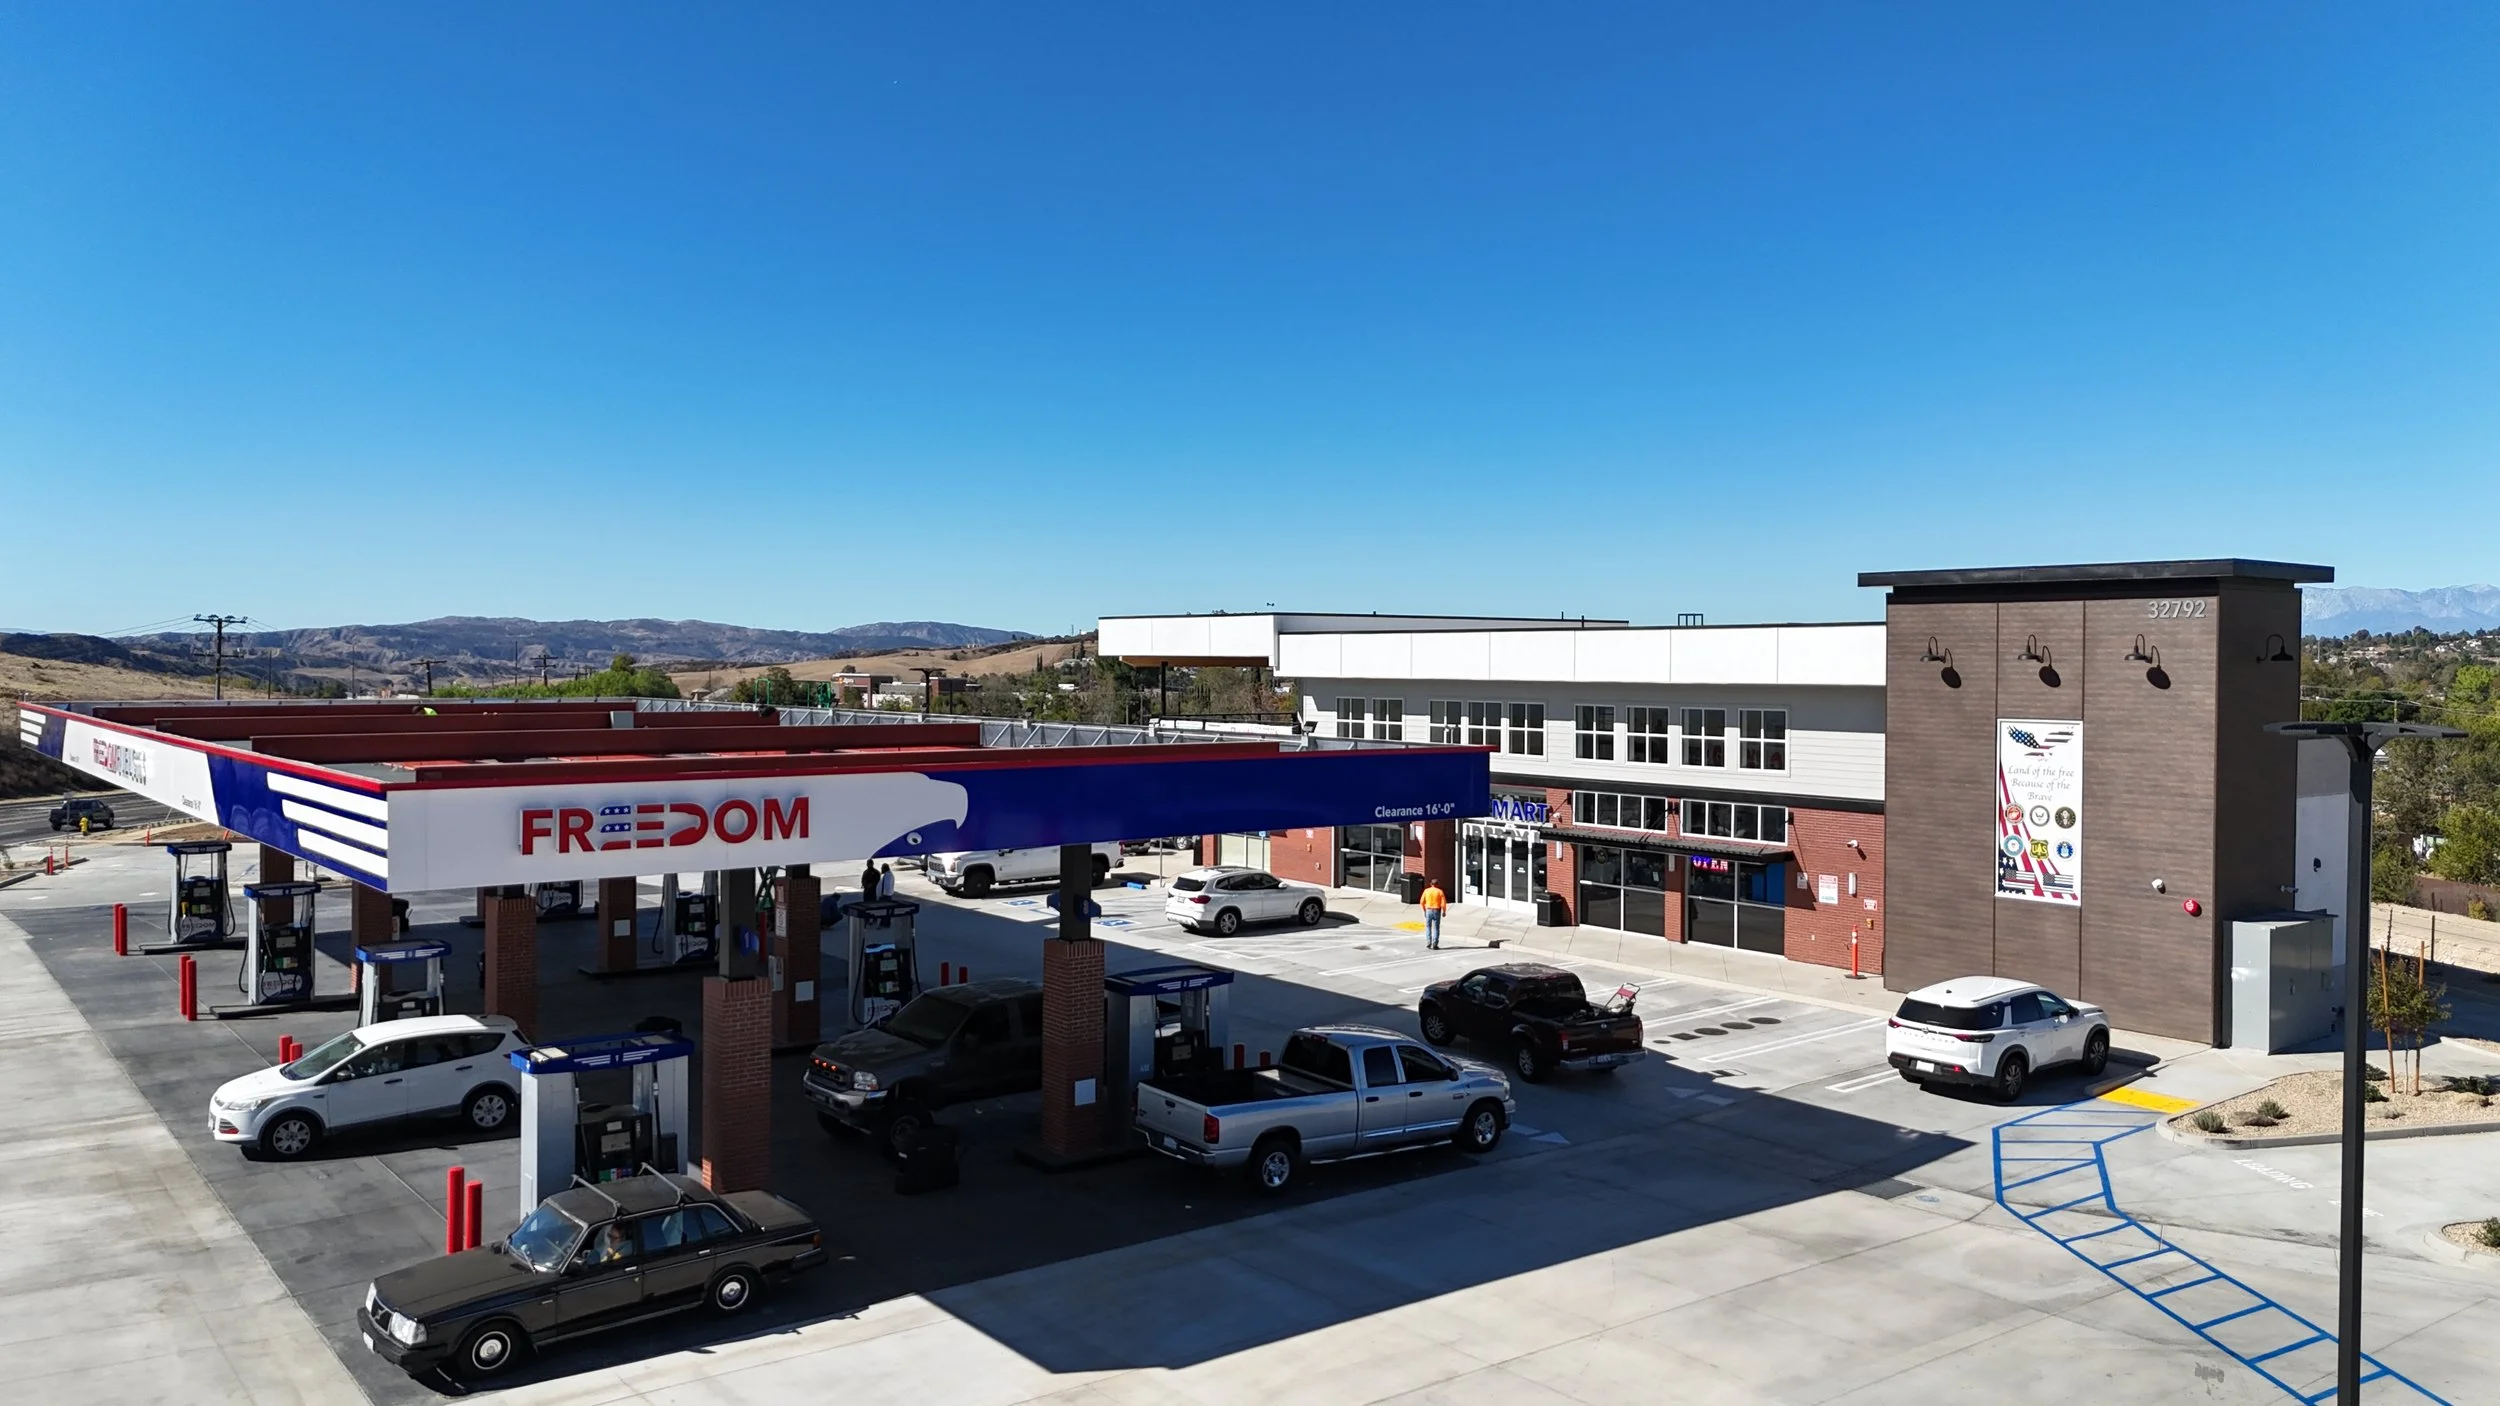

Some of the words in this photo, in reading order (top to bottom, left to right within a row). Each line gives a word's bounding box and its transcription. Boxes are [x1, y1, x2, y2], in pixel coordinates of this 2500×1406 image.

[2148, 600, 2206, 619] 32792
[2008, 765, 2031, 775] Land
[2032, 766, 2042, 779] of
[2043, 766, 2055, 776] the
[2057, 767, 2074, 779] free
[2011, 778, 2044, 789] Because
[2046, 780, 2055, 792] of
[2057, 779, 2071, 789] the
[2027, 791, 2053, 801] Brave
[1375, 804, 1423, 818] Clearance
[1426, 803, 1456, 815] 16'-0"
[1491, 799, 1549, 823] MART
[520, 796, 810, 856] FREEDOM
[2232, 1159, 2315, 1189] LOADING
